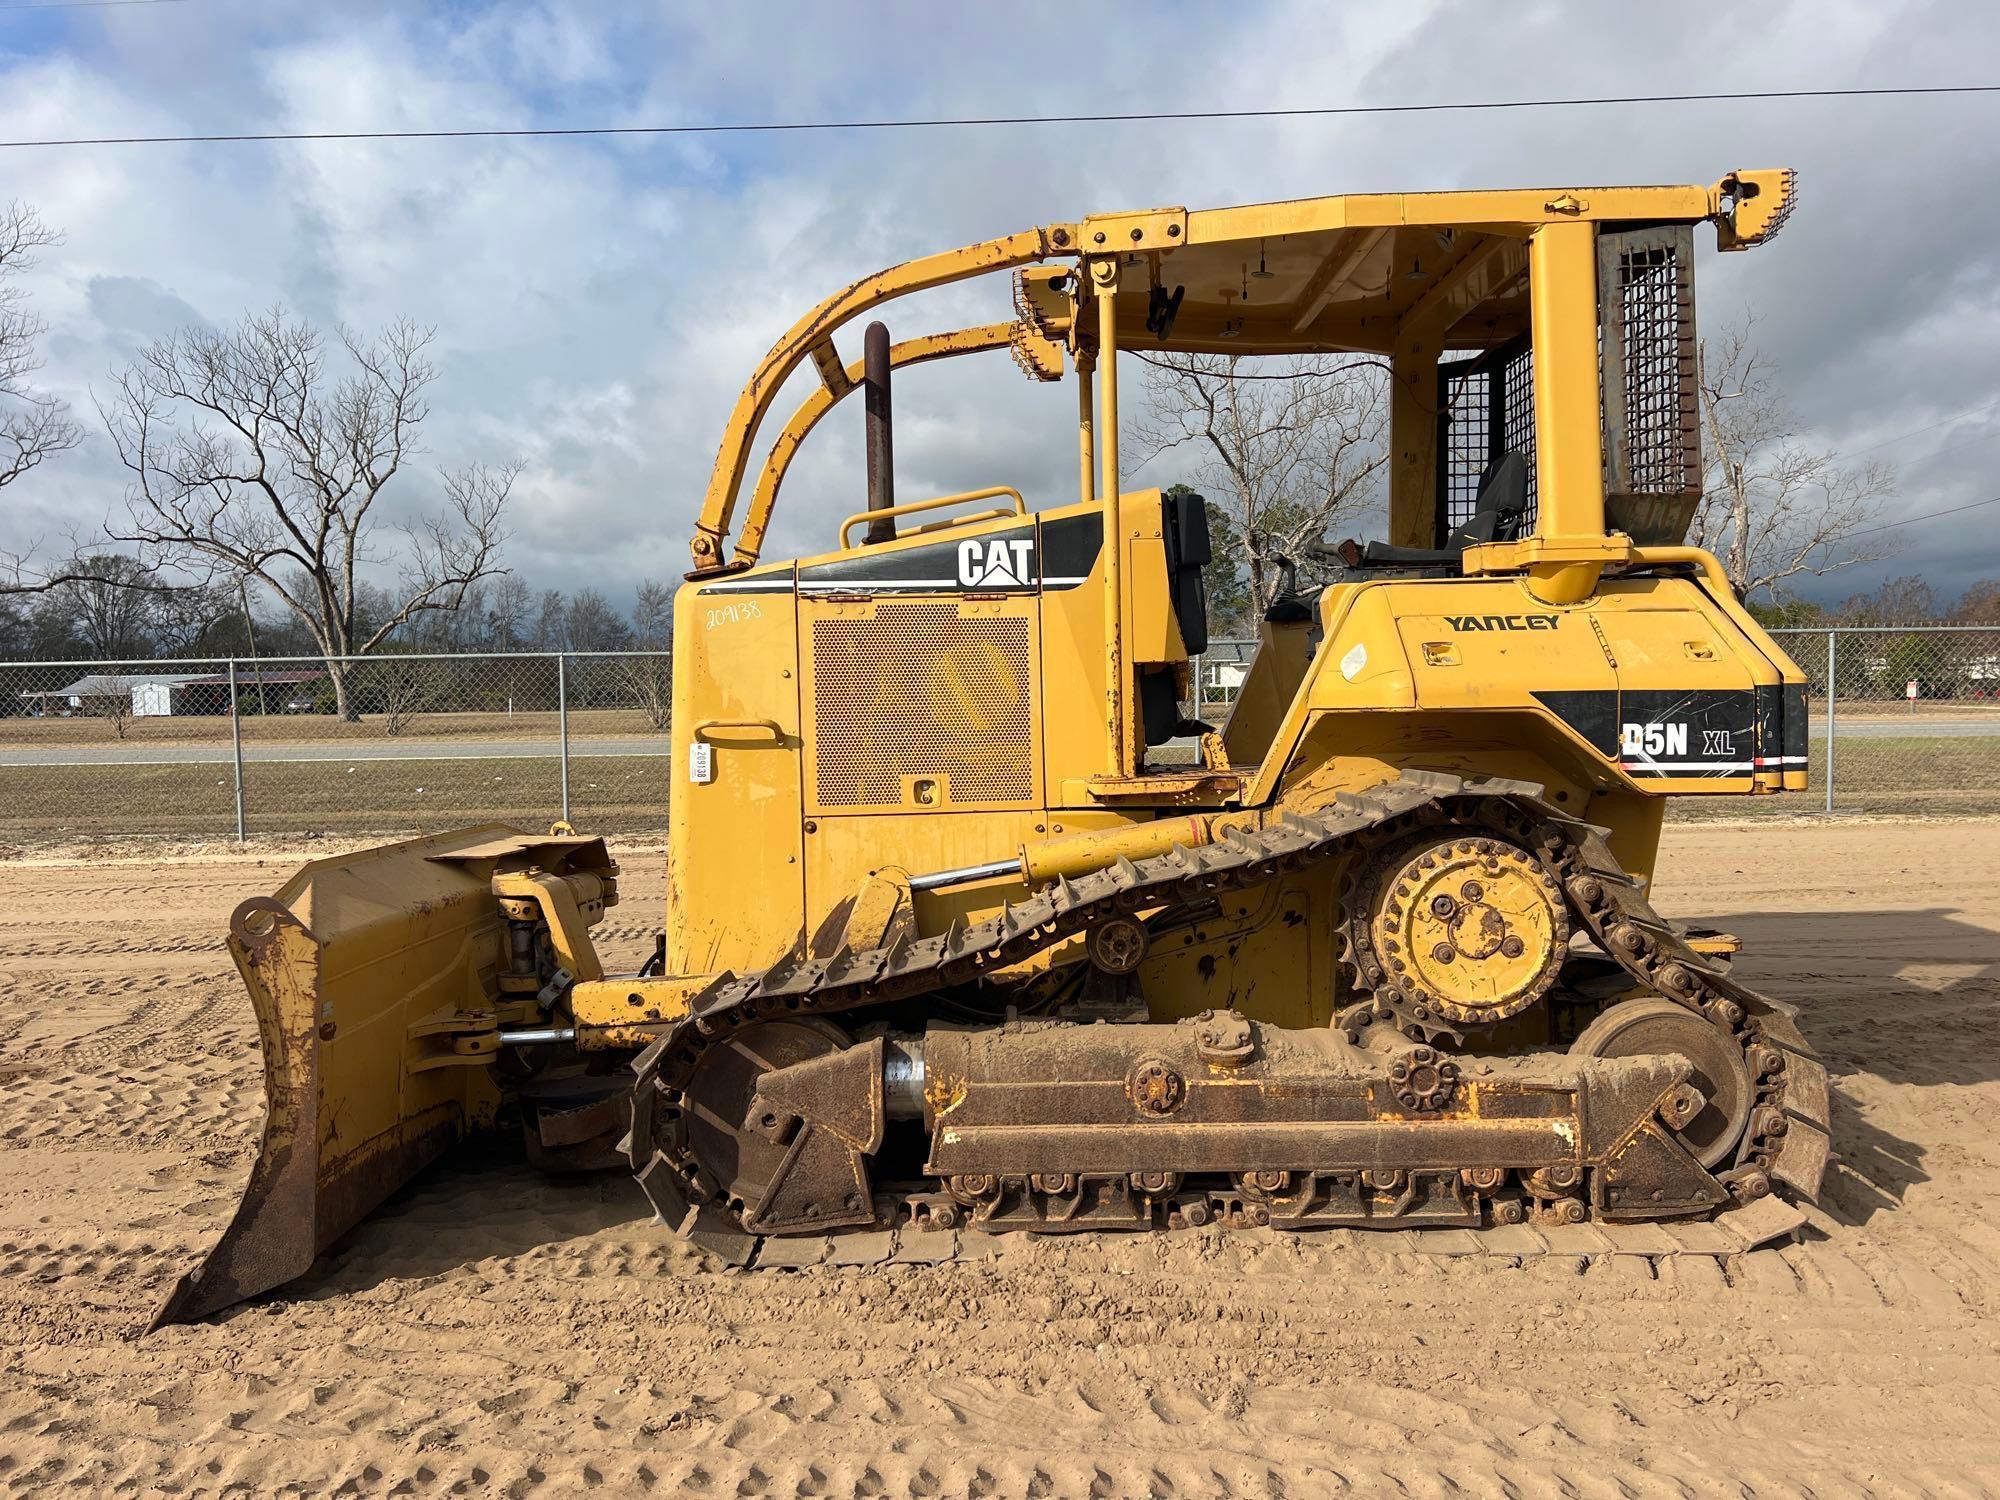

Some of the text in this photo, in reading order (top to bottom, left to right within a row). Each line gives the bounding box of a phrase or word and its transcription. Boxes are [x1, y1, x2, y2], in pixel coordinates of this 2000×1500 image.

[958, 539, 1034, 586] CAT
[706, 600, 762, 631] 209138
[1443, 615, 1560, 631] YANCEY
[1622, 722, 1736, 755] D5N XL
[696, 751, 707, 777] 209138
